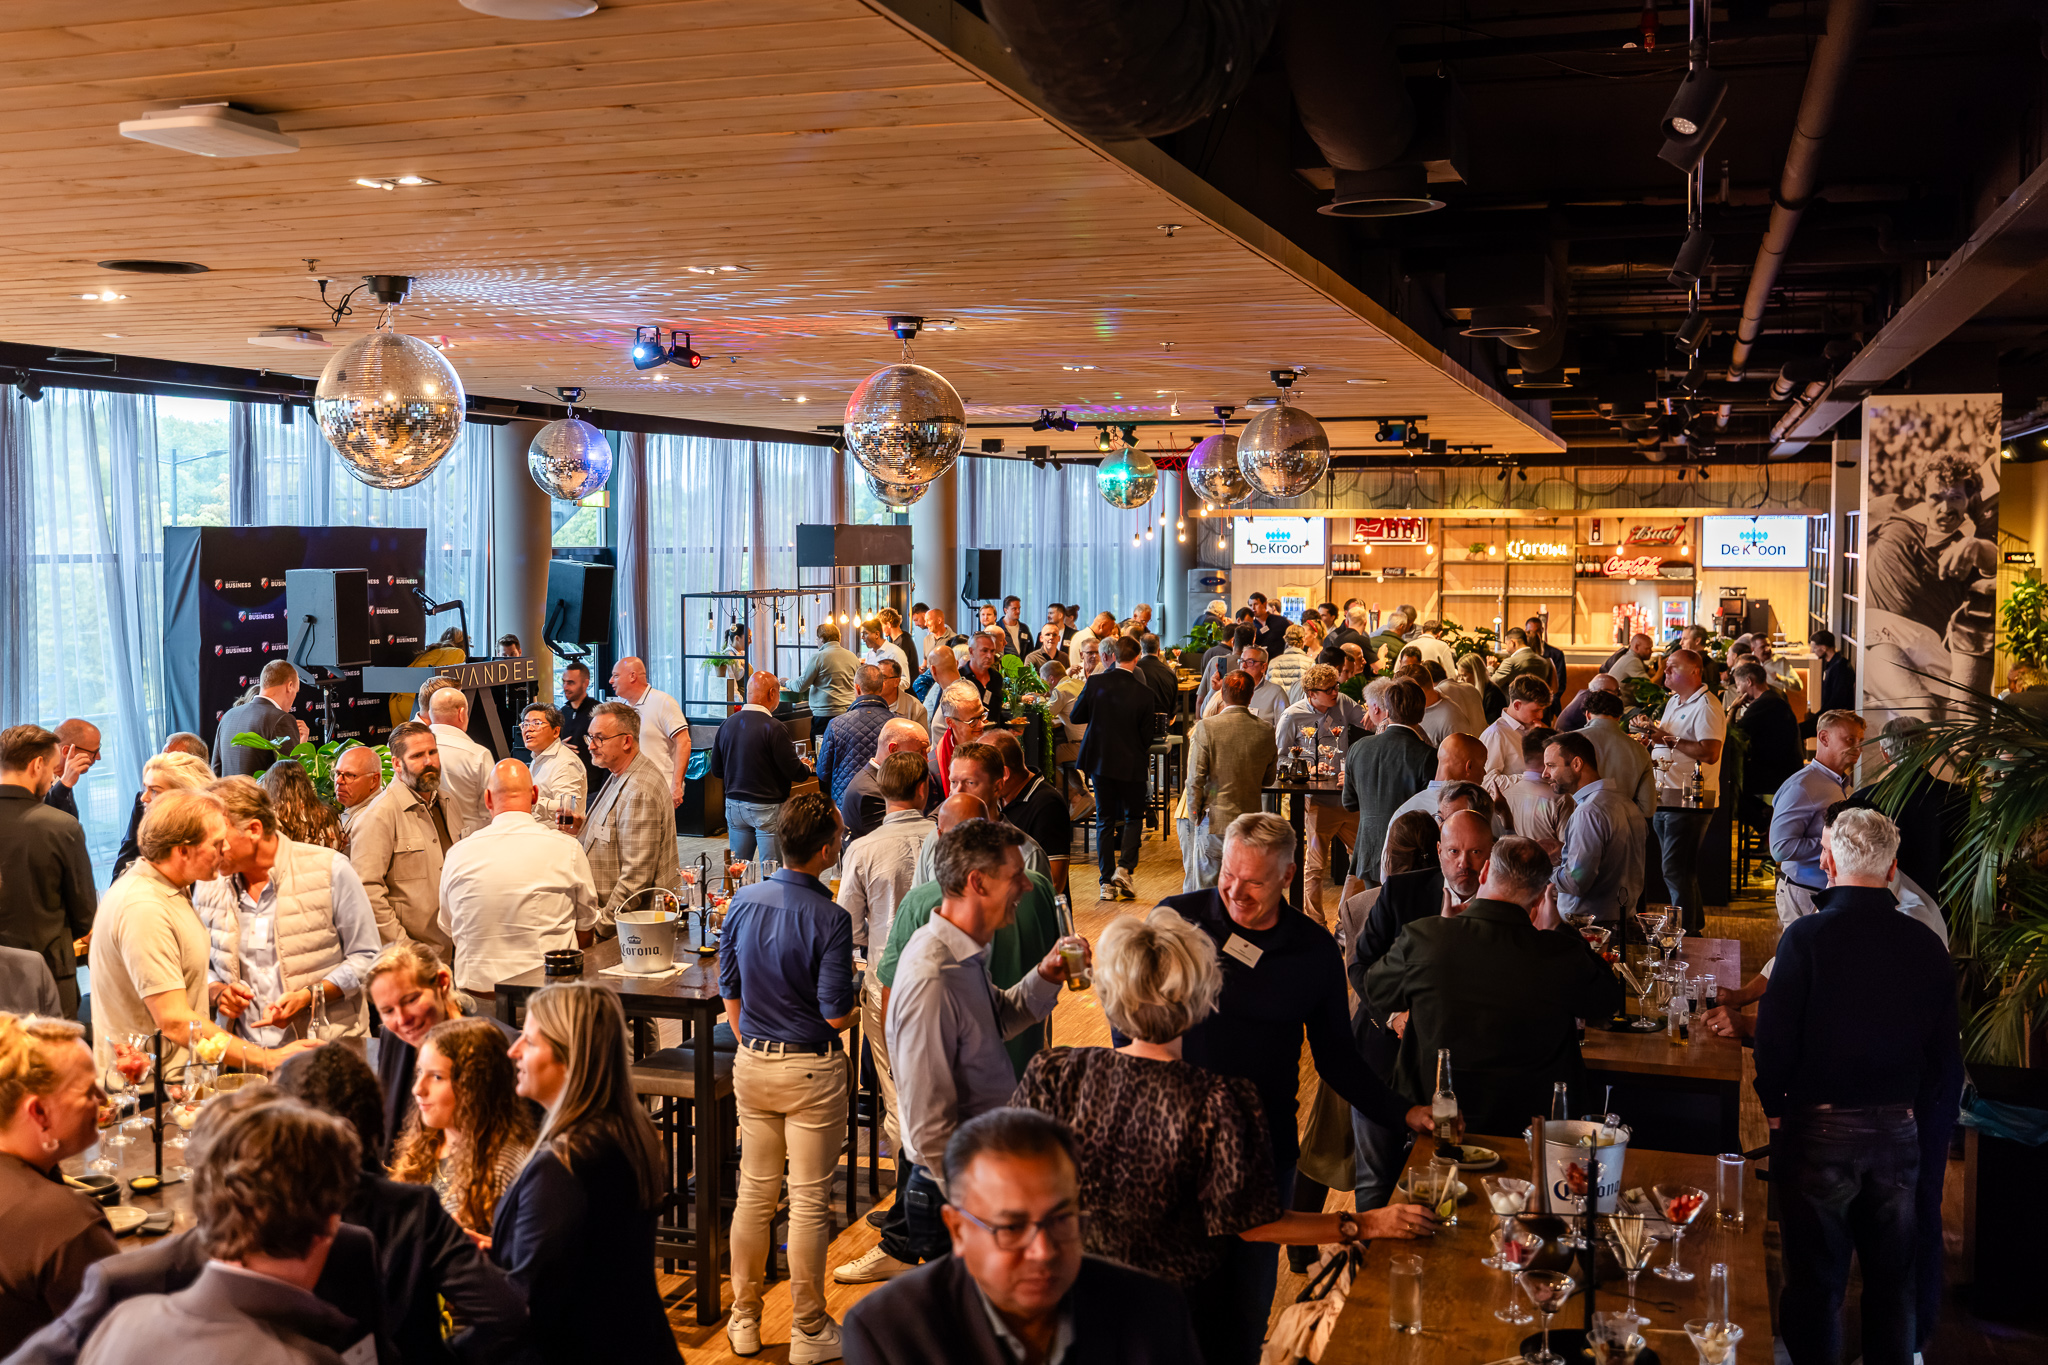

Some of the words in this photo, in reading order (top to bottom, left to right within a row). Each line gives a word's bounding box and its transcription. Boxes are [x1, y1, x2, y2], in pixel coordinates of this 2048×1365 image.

[1635, 525, 1677, 540] Bud
[1250, 543, 1267, 554] De
[1508, 539, 1567, 560] Corona
[1721, 544, 1740, 555] De
[1742, 544, 1786, 555] Koon
[357, 698, 380, 706] BUSINESS
[620, 943, 660, 957] Corona
[1553, 1179, 1620, 1204] Cona
